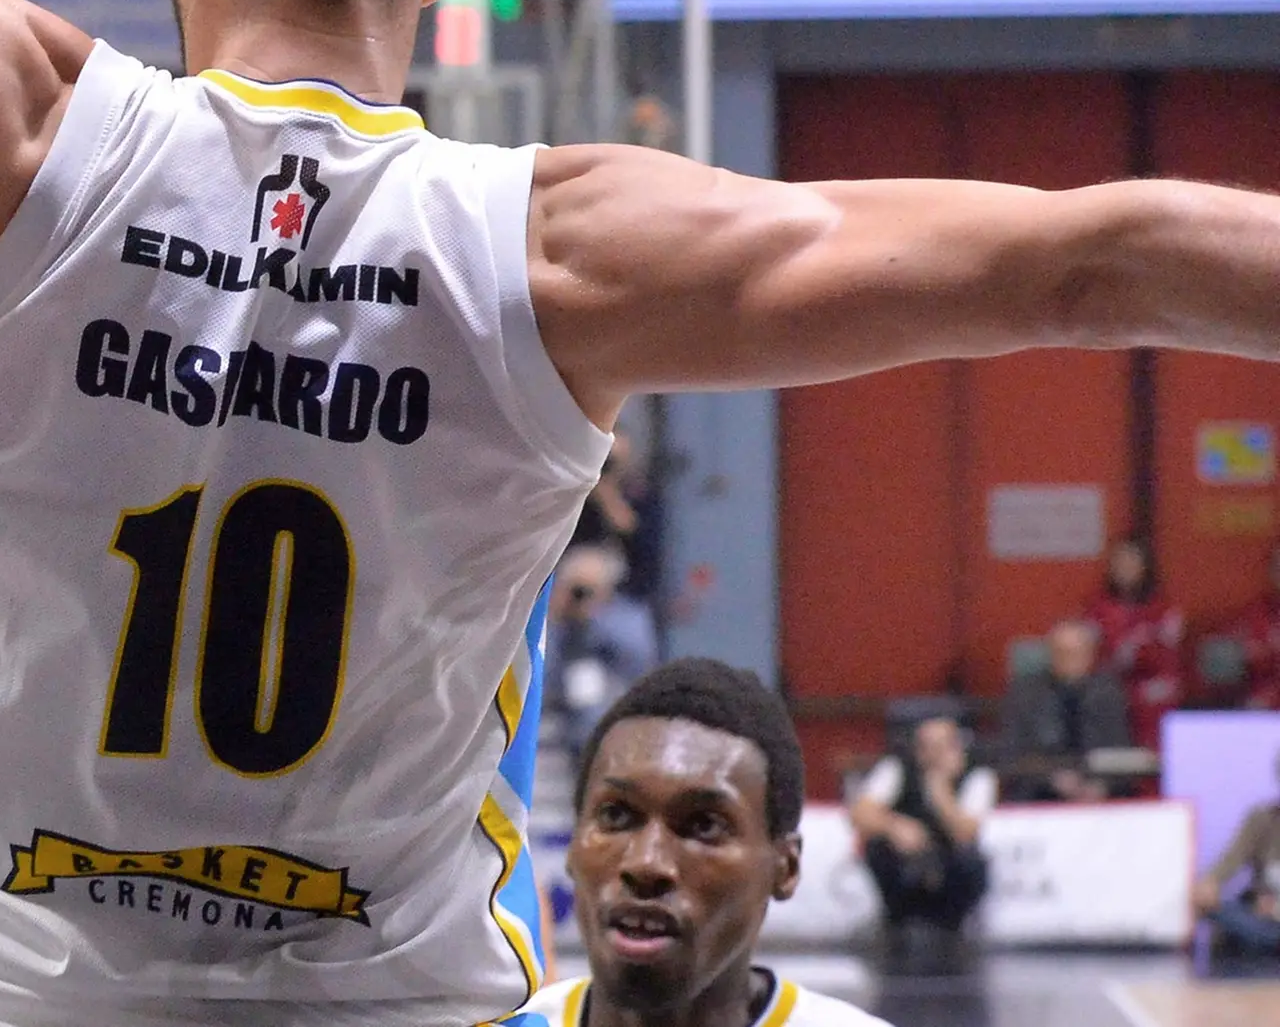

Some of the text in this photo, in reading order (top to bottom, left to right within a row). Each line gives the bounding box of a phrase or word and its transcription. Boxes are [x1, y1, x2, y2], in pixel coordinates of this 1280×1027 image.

[75, 318, 431, 445] GASARDO
[97, 477, 357, 779] 10
[89, 877, 284, 931] CREMONA
